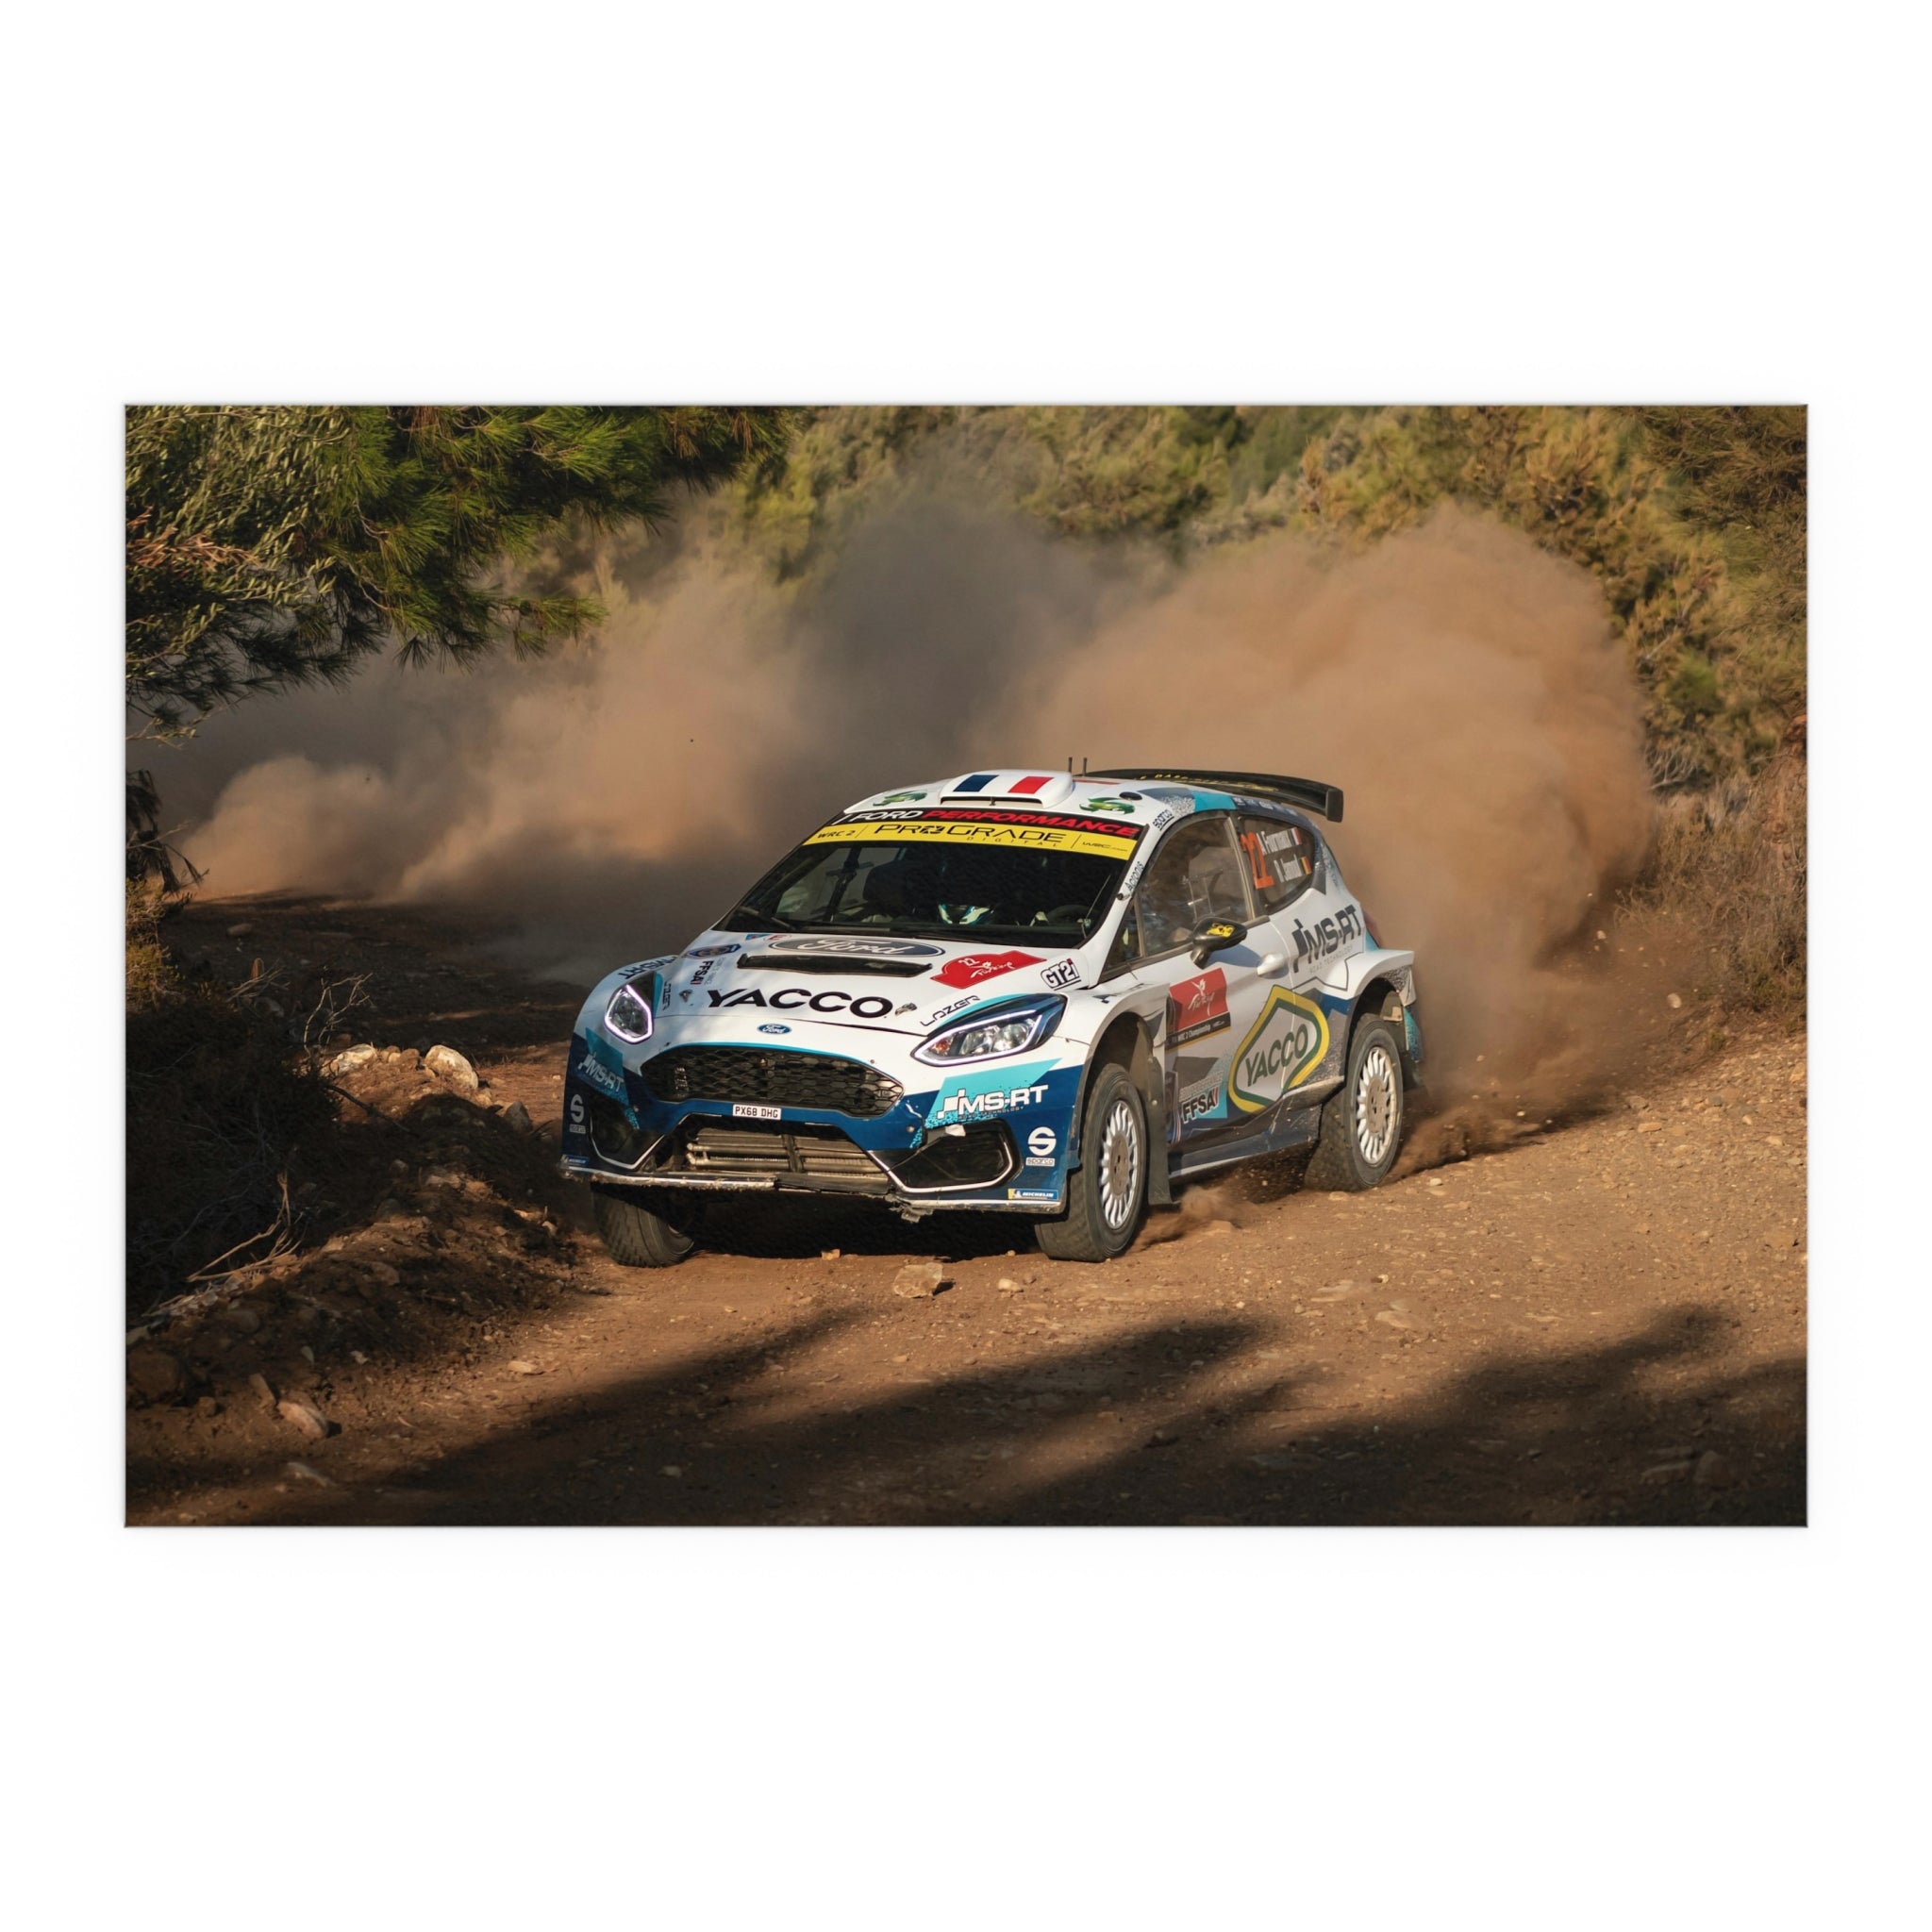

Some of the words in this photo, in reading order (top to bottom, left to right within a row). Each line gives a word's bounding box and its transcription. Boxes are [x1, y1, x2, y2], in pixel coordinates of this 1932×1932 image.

[817, 830, 845, 839] WRC
[849, 810, 924, 823] FORD
[921, 809, 1141, 838] PERFORMANCE
[966, 836, 1058, 847] DIGITAL
[798, 939, 915, 955] Ford
[708, 988, 893, 1019] YACCO
[759, 1024, 790, 1034] Ford
[1245, 1024, 1308, 1088] YACCO
[734, 1107, 758, 1117] PX68
[760, 1108, 779, 1119] DHG
[1182, 1090, 1216, 1124] FFSA
[1027, 1126, 1057, 1157] S
